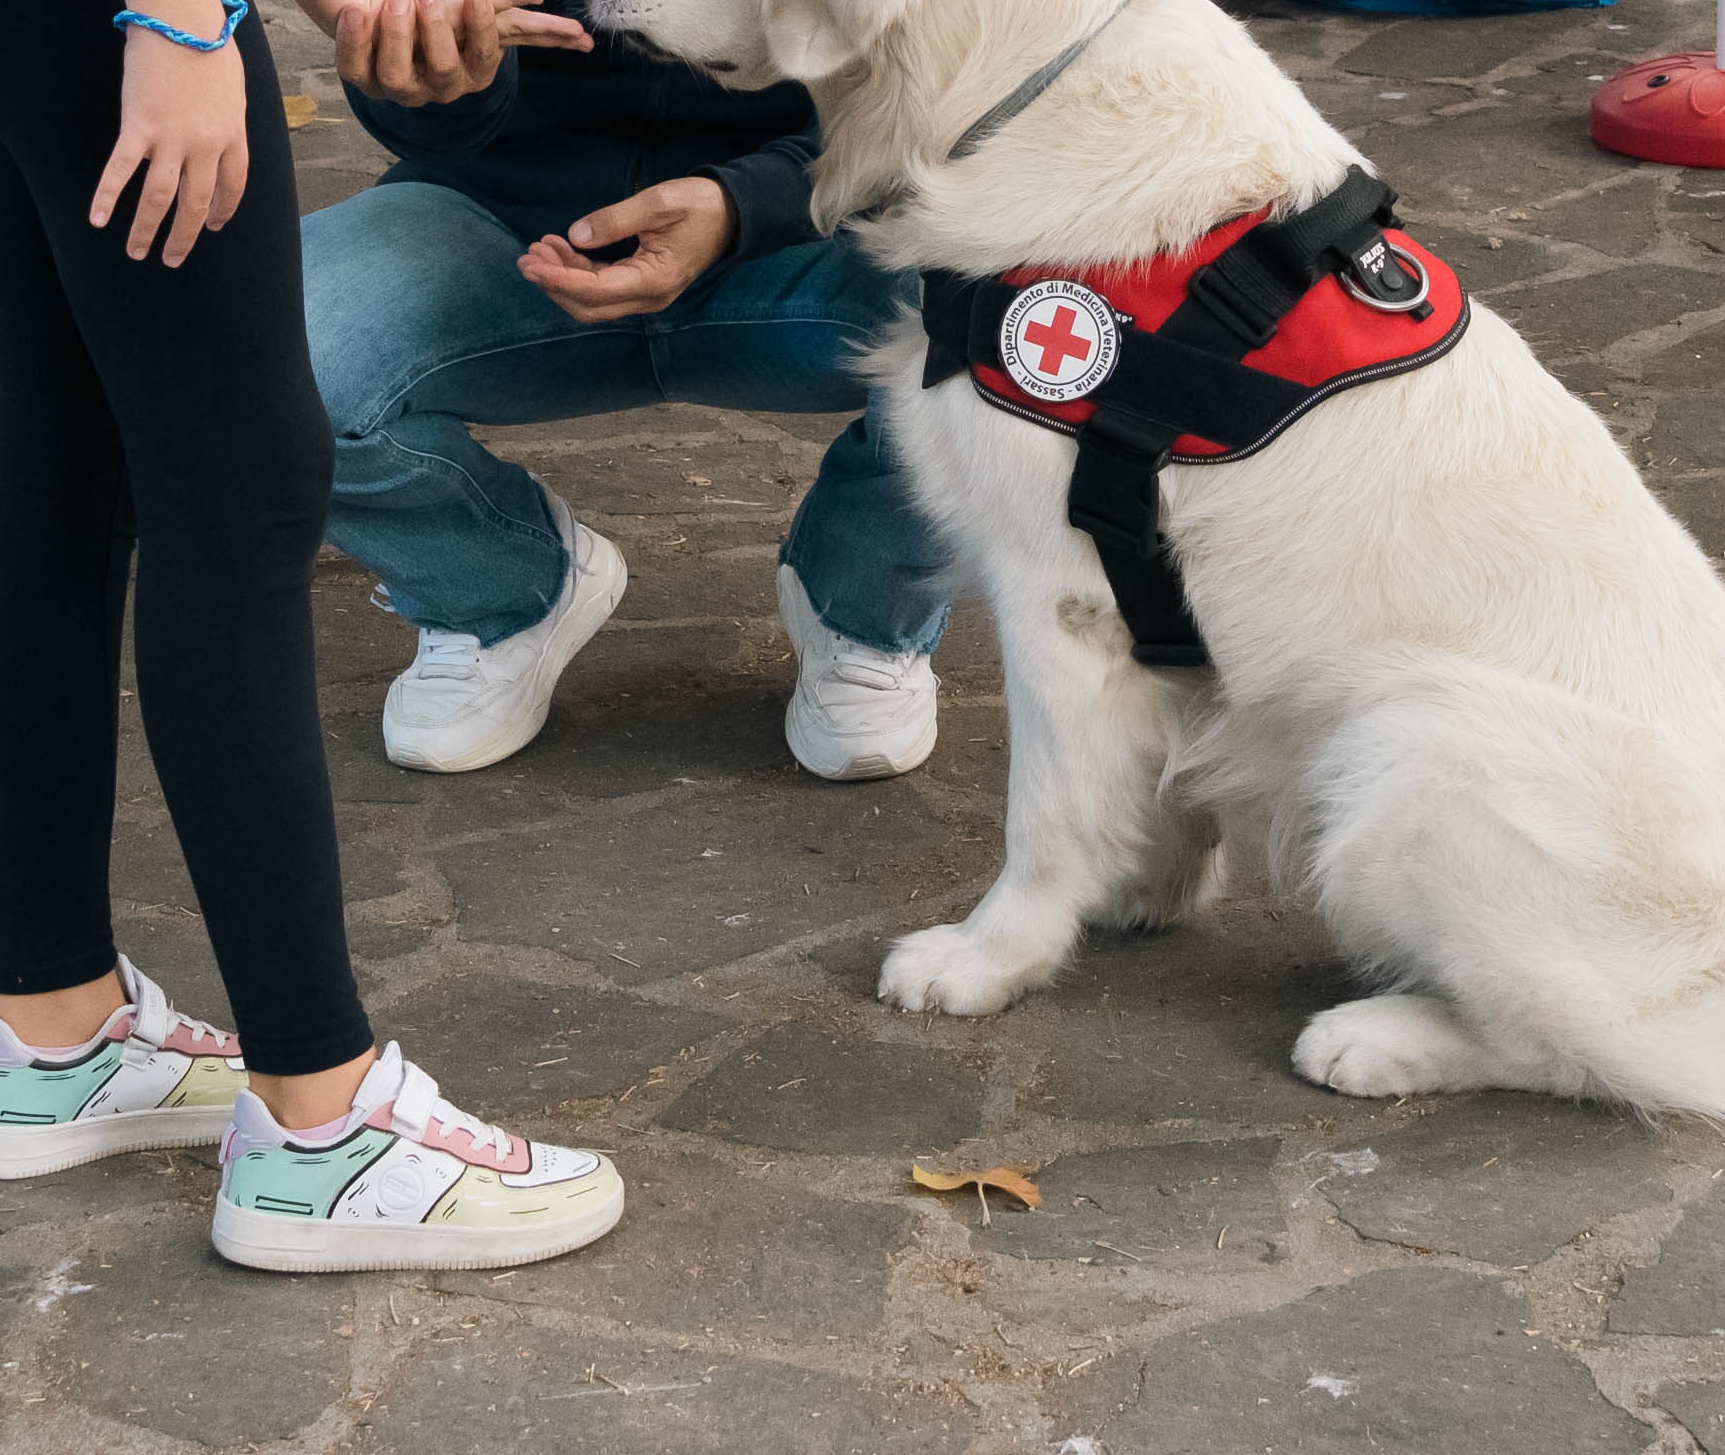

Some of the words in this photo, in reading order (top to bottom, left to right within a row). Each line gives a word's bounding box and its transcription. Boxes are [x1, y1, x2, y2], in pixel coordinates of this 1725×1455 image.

[1360, 242, 1386, 268] JULIUS
[1046, 282, 1059, 294] di
[1061, 283, 1109, 327] Medicina
[1004, 287, 1044, 367] Dipartimento
[1074, 328, 1115, 389] Veterinaria
[1020, 374, 1065, 399] Sassari
